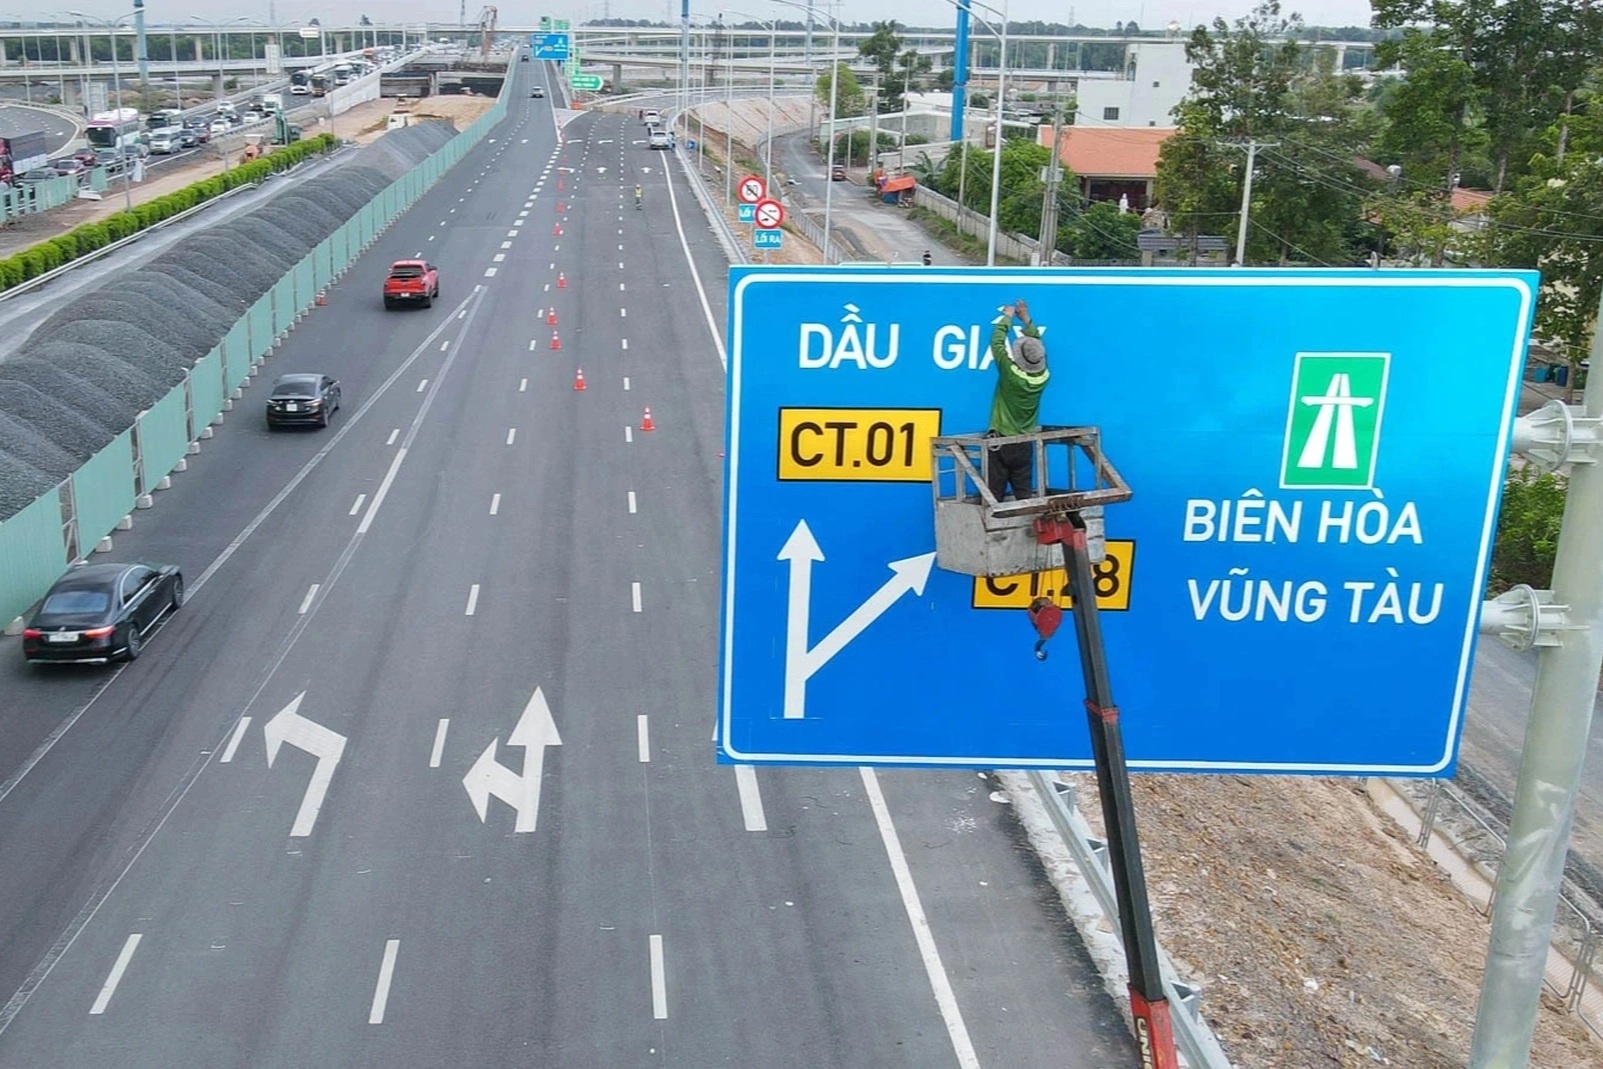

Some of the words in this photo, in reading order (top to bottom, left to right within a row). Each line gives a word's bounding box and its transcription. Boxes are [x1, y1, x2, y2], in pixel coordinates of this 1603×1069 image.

[769, 234, 781, 244] RA
[799, 303, 899, 369] DẦU
[791, 421, 915, 467] CT.01
[1183, 488, 1303, 543] BIÊN
[1317, 487, 1423, 544] HÒA
[1187, 567, 1328, 623] VŨNG
[1343, 567, 1444, 624] TÀU
